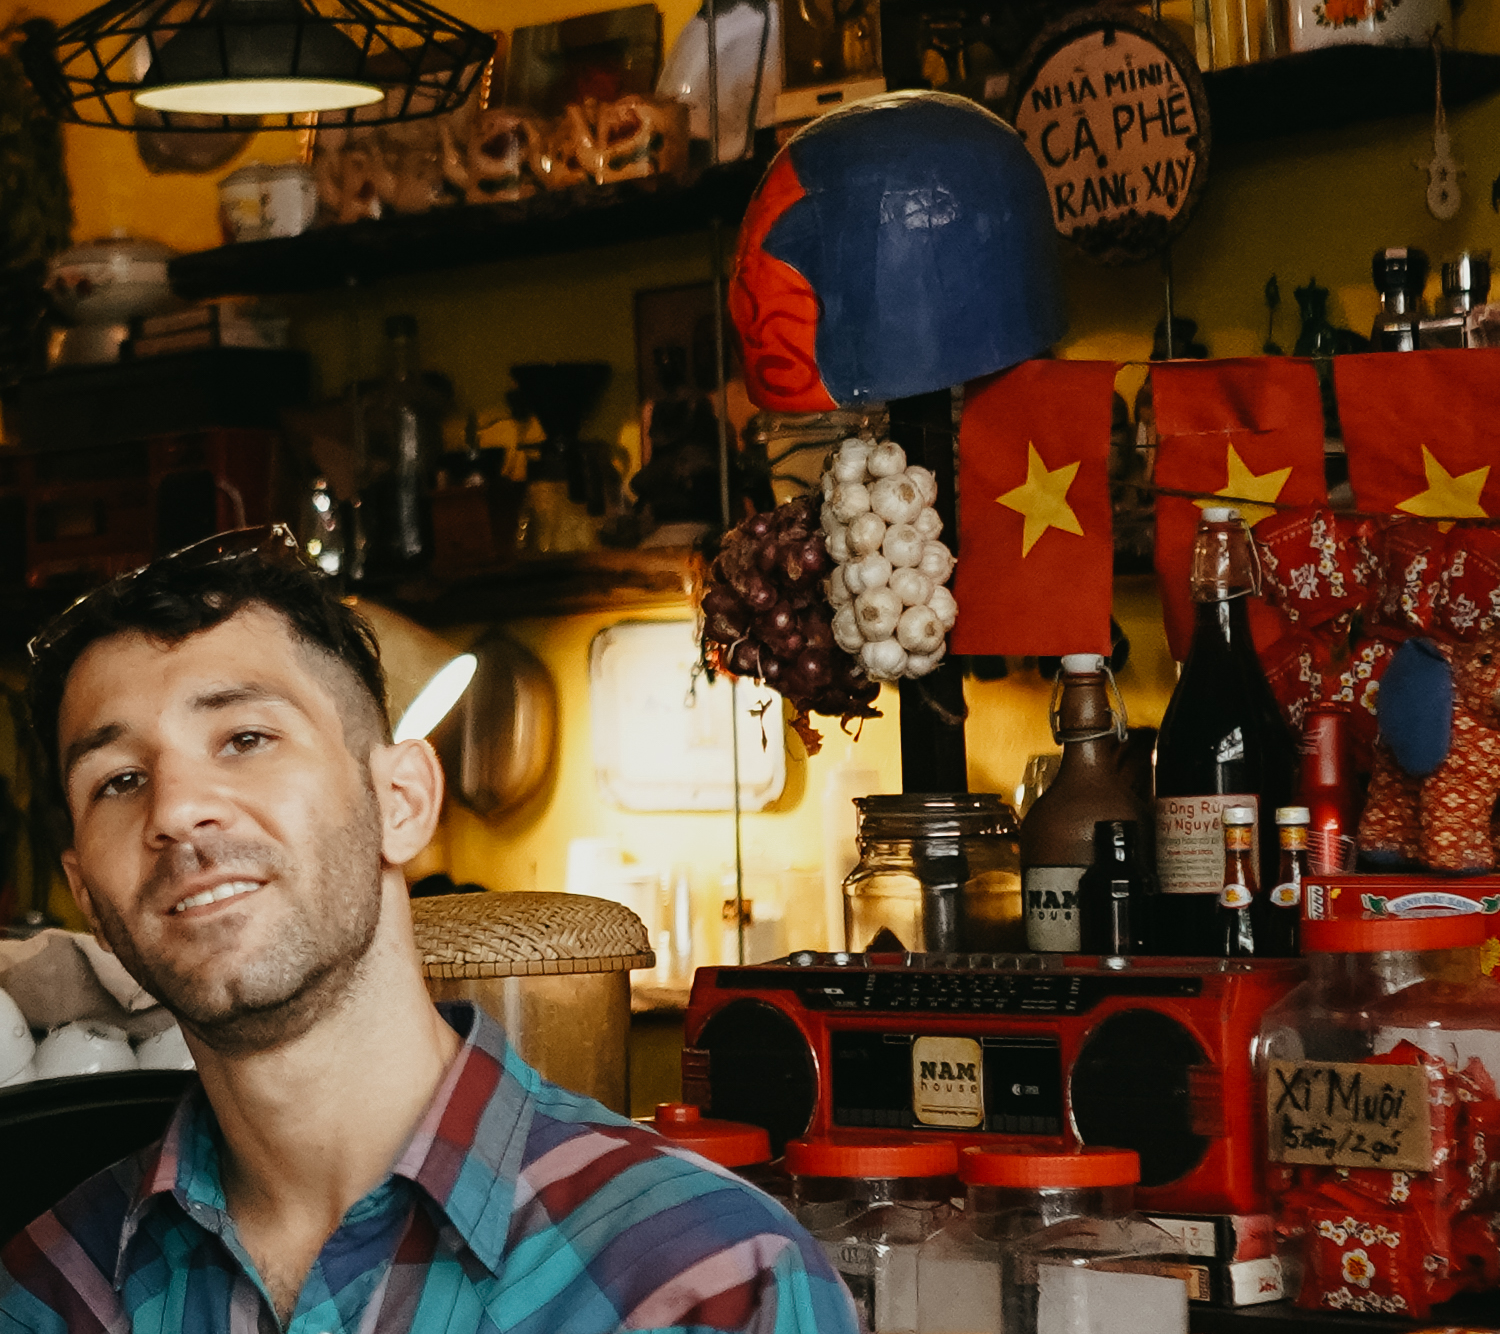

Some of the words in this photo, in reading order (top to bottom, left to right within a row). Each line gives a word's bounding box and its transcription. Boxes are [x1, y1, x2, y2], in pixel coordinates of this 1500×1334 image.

[1112, 82, 1192, 151] PHÊ
[1054, 173, 1138, 223] RANG
[1175, 816, 1220, 836] Nguyê
[920, 1061, 978, 1081] NAM
[920, 1080, 979, 1094] house
